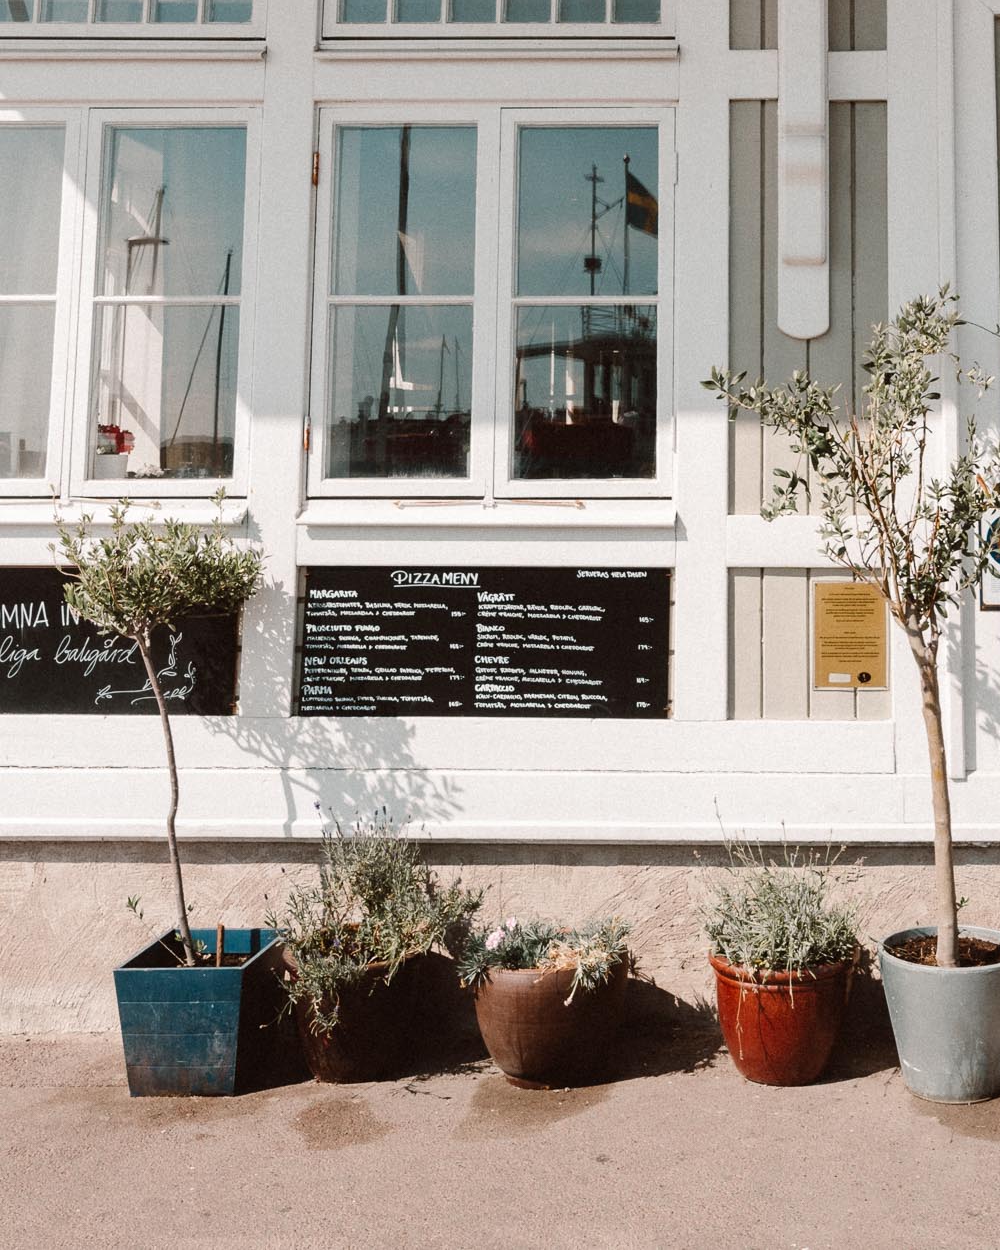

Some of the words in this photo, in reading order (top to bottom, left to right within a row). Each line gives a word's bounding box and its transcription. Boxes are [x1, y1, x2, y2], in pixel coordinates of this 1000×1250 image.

[310, 589, 358, 599] MARGARITA
[304, 655, 326, 666] NEW
[329, 656, 368, 665] ORLEANS
[301, 684, 332, 695] PARMA
